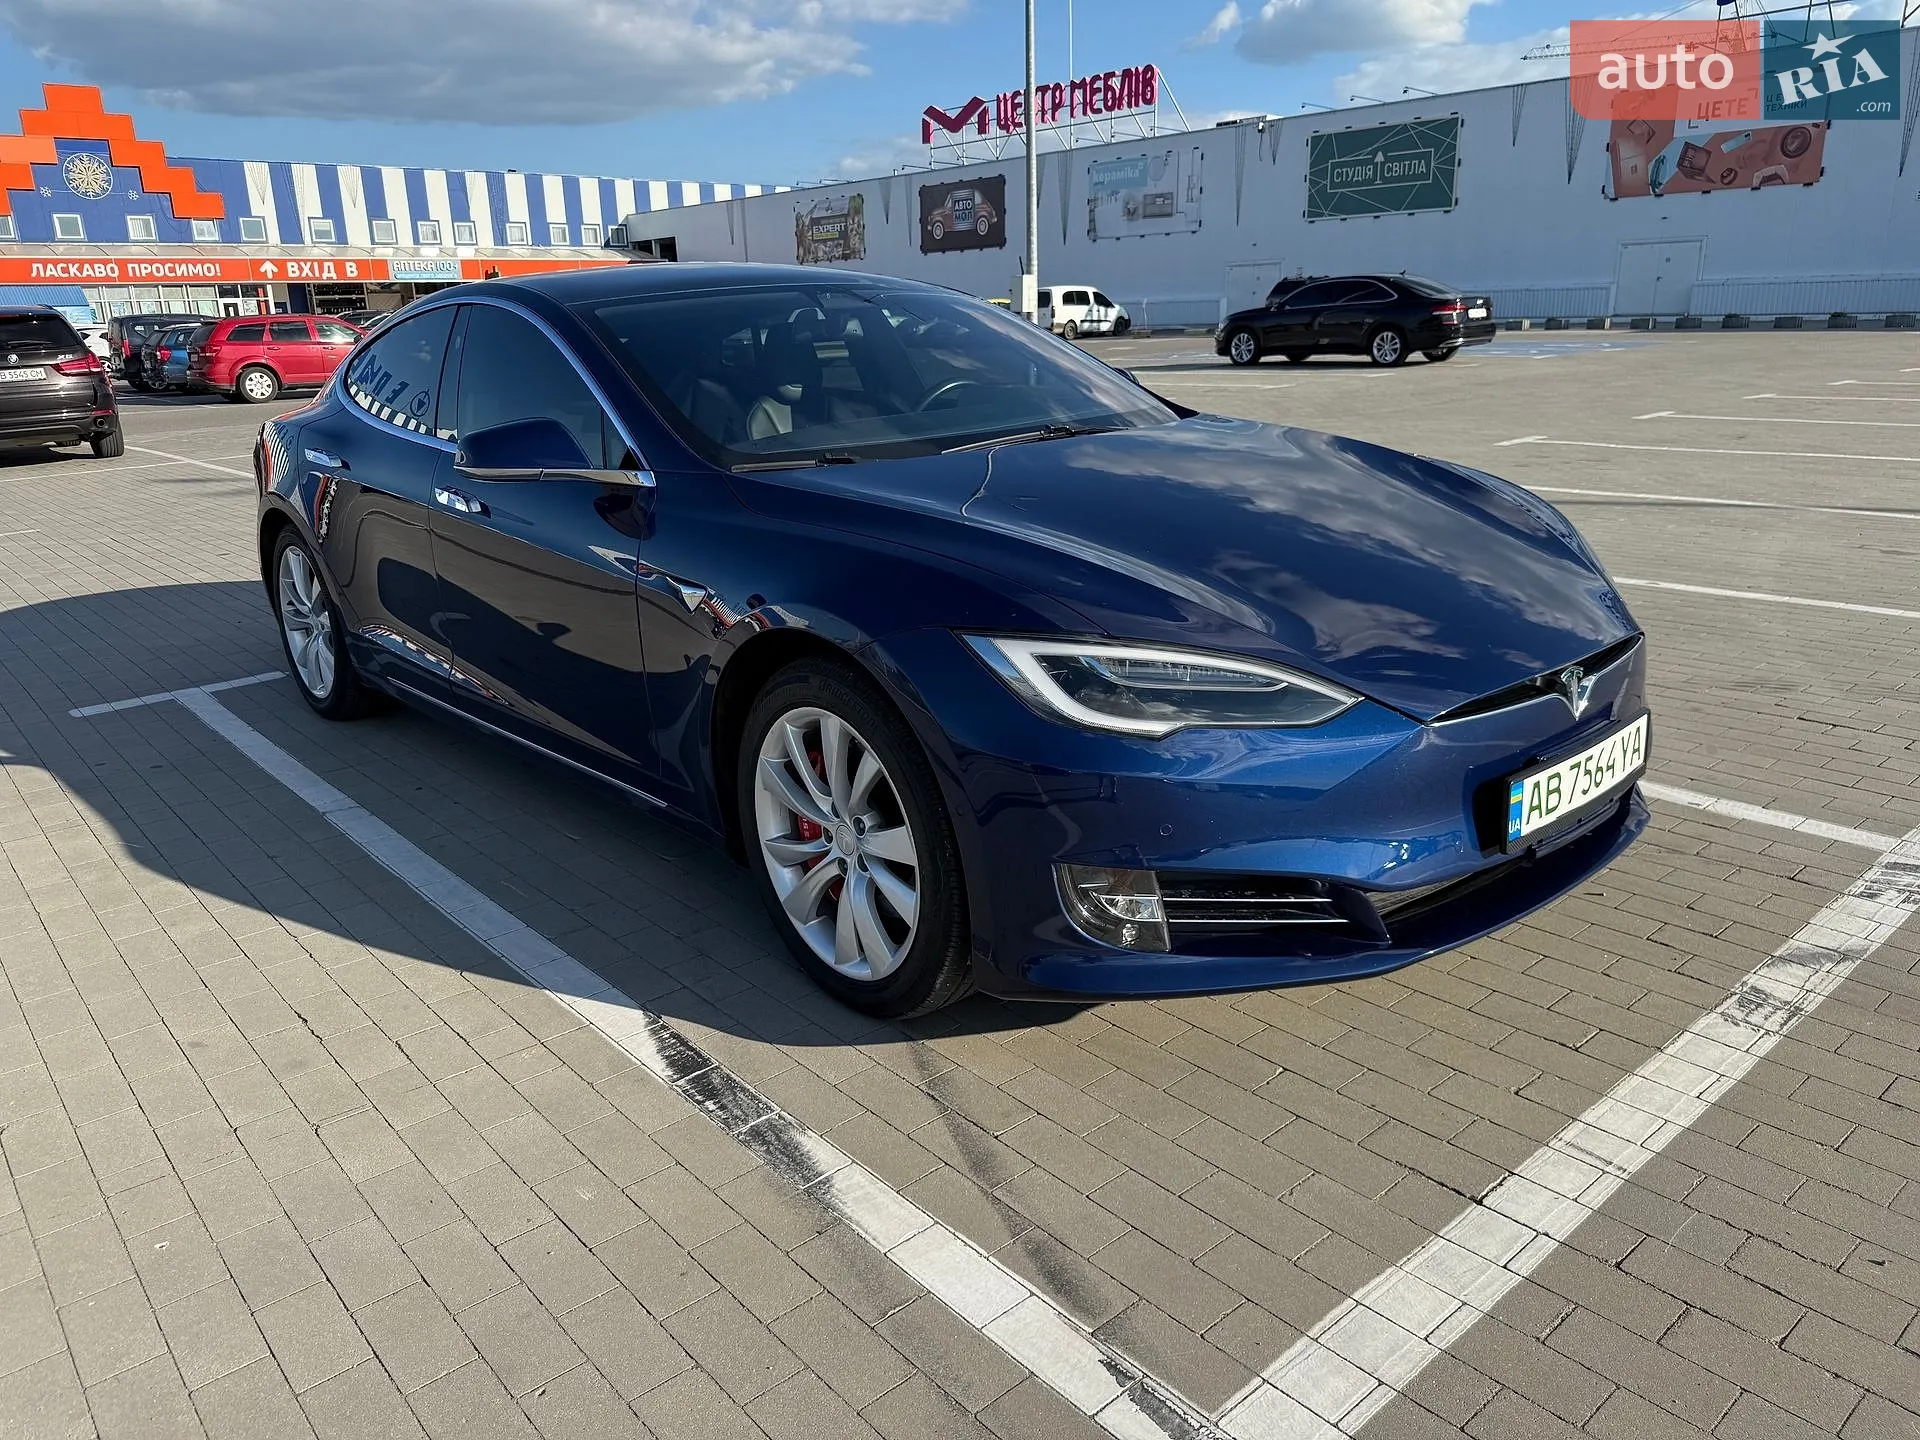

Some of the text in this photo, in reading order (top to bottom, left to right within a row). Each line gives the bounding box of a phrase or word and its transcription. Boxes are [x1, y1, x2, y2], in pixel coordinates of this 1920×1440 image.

[996, 82, 1065, 134] ЦЕТР
[1070, 64, 1158, 118] МЕБЛІВ
[1334, 160, 1426, 183] СТУДІЯ СВІТЛА
[954, 200, 972, 210] АВТО
[813, 223, 846, 233] EXPERT
[31, 263, 222, 278] ЛАСКАВО ПРОСИМО!
[286, 261, 359, 280] ВХІД В
[393, 260, 434, 271] АПТЕКА
[9, 371, 28, 379] 5545
[30, 370, 43, 378] CM
[1526, 725, 1641, 826] AB 7564 YA
[1509, 819, 1520, 833] UA
